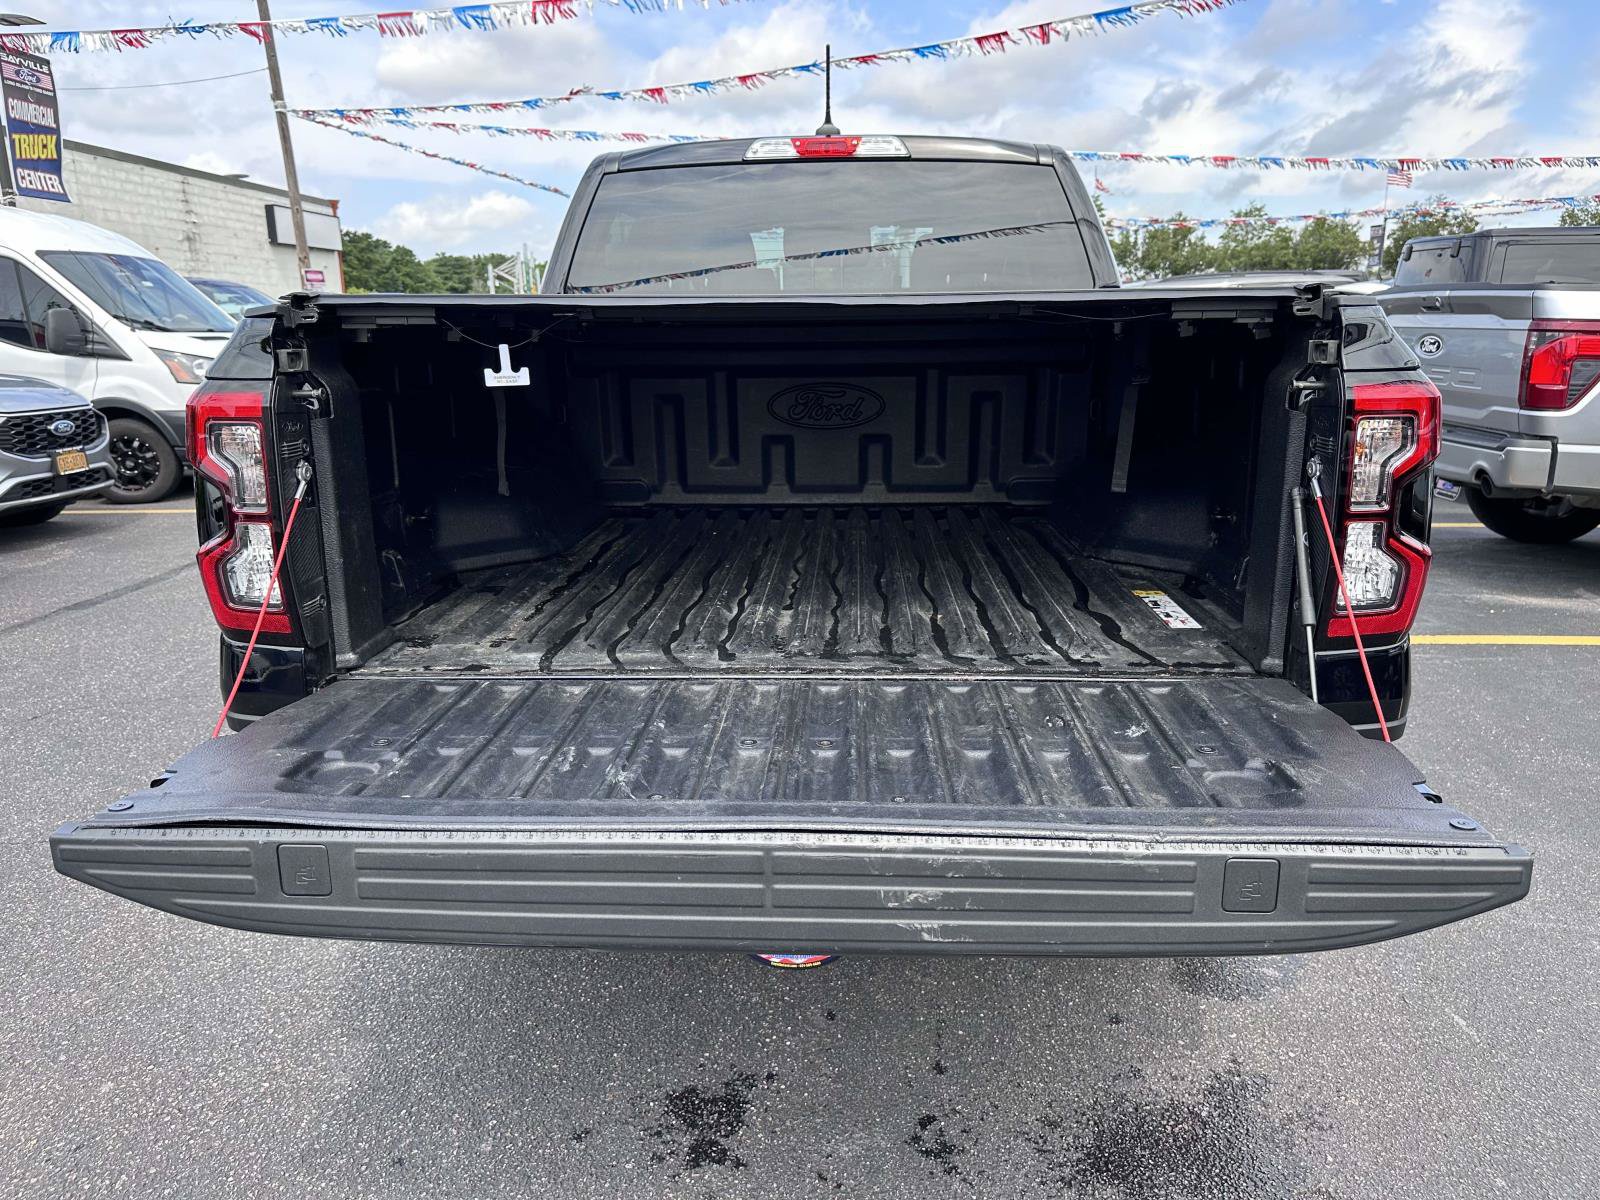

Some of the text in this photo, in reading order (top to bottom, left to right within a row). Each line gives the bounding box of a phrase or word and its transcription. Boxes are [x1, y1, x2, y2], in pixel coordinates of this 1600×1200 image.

[8, 98, 57, 128] COMMERCIAL
[12, 134, 58, 160] TRUCK
[16, 167, 64, 194] CENTER
[788, 389, 865, 422] Ford
